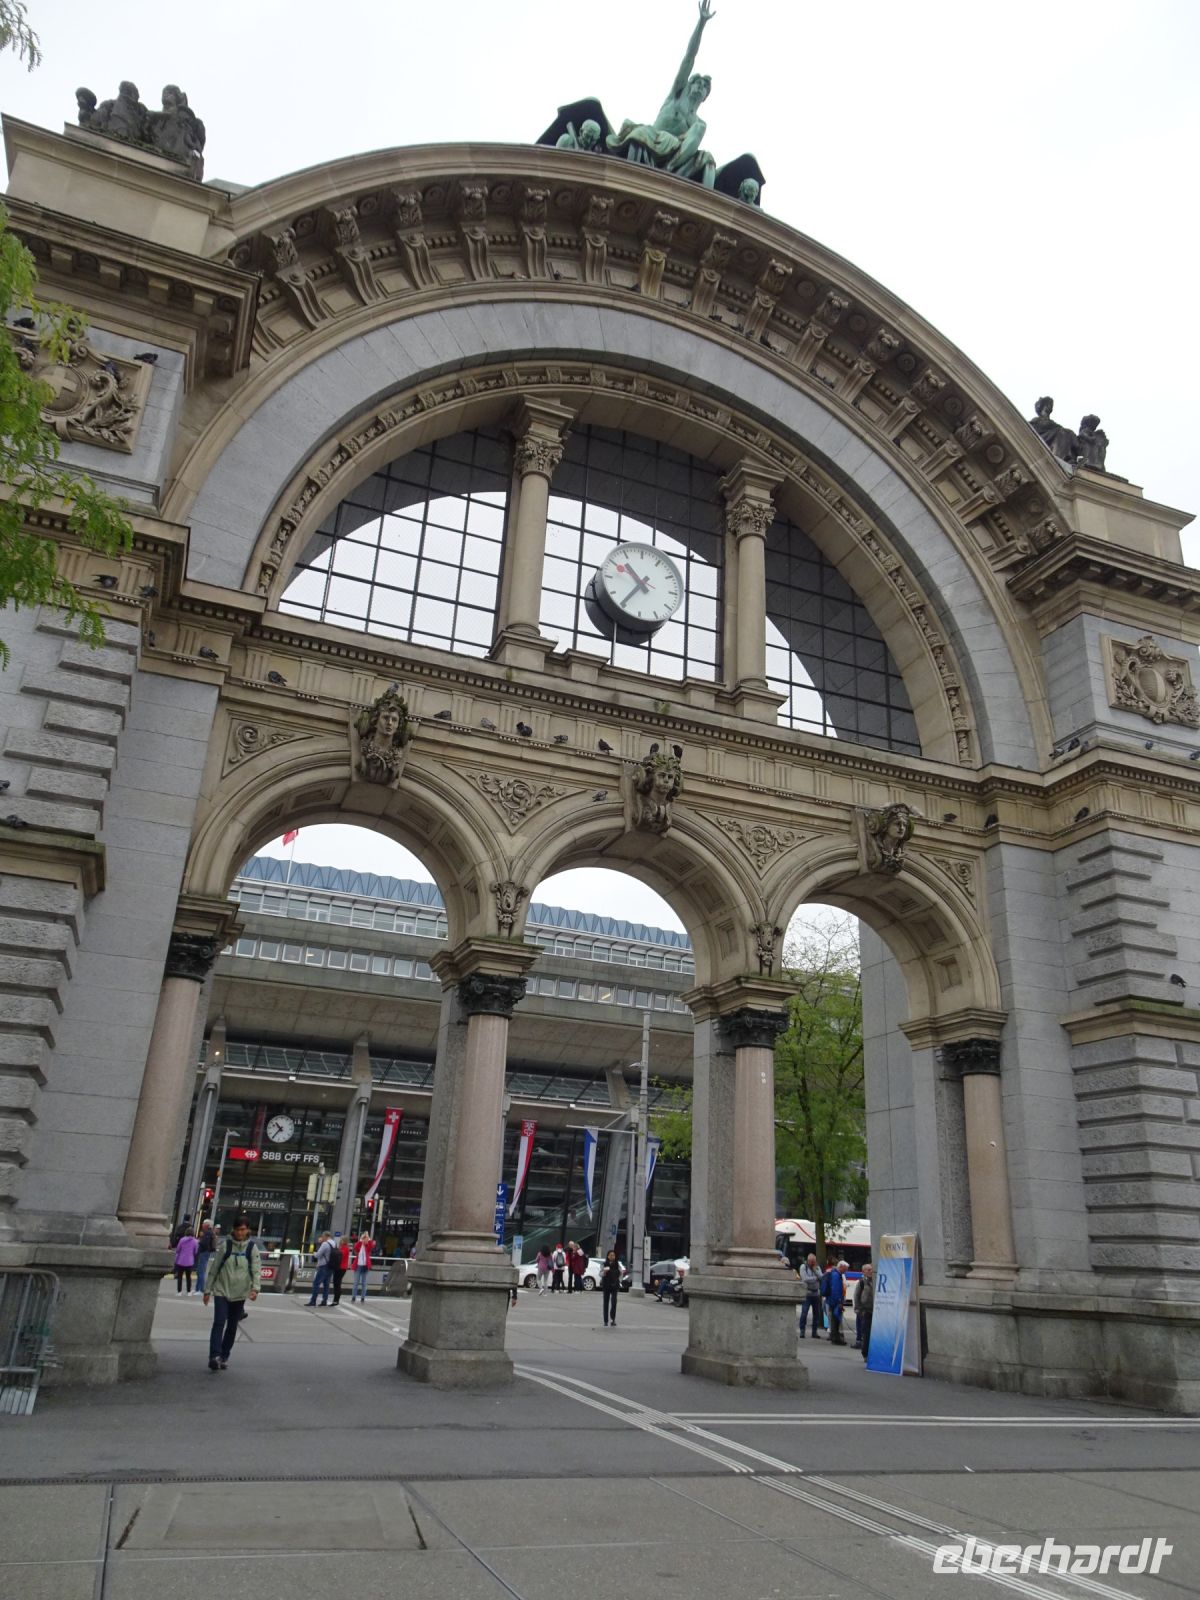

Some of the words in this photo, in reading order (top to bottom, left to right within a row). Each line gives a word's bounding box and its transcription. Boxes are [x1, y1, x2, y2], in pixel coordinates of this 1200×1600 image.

[262, 1151, 282, 1161] SBB
[284, 1153, 302, 1162] CFF
[303, 1154, 320, 1163] FFS
